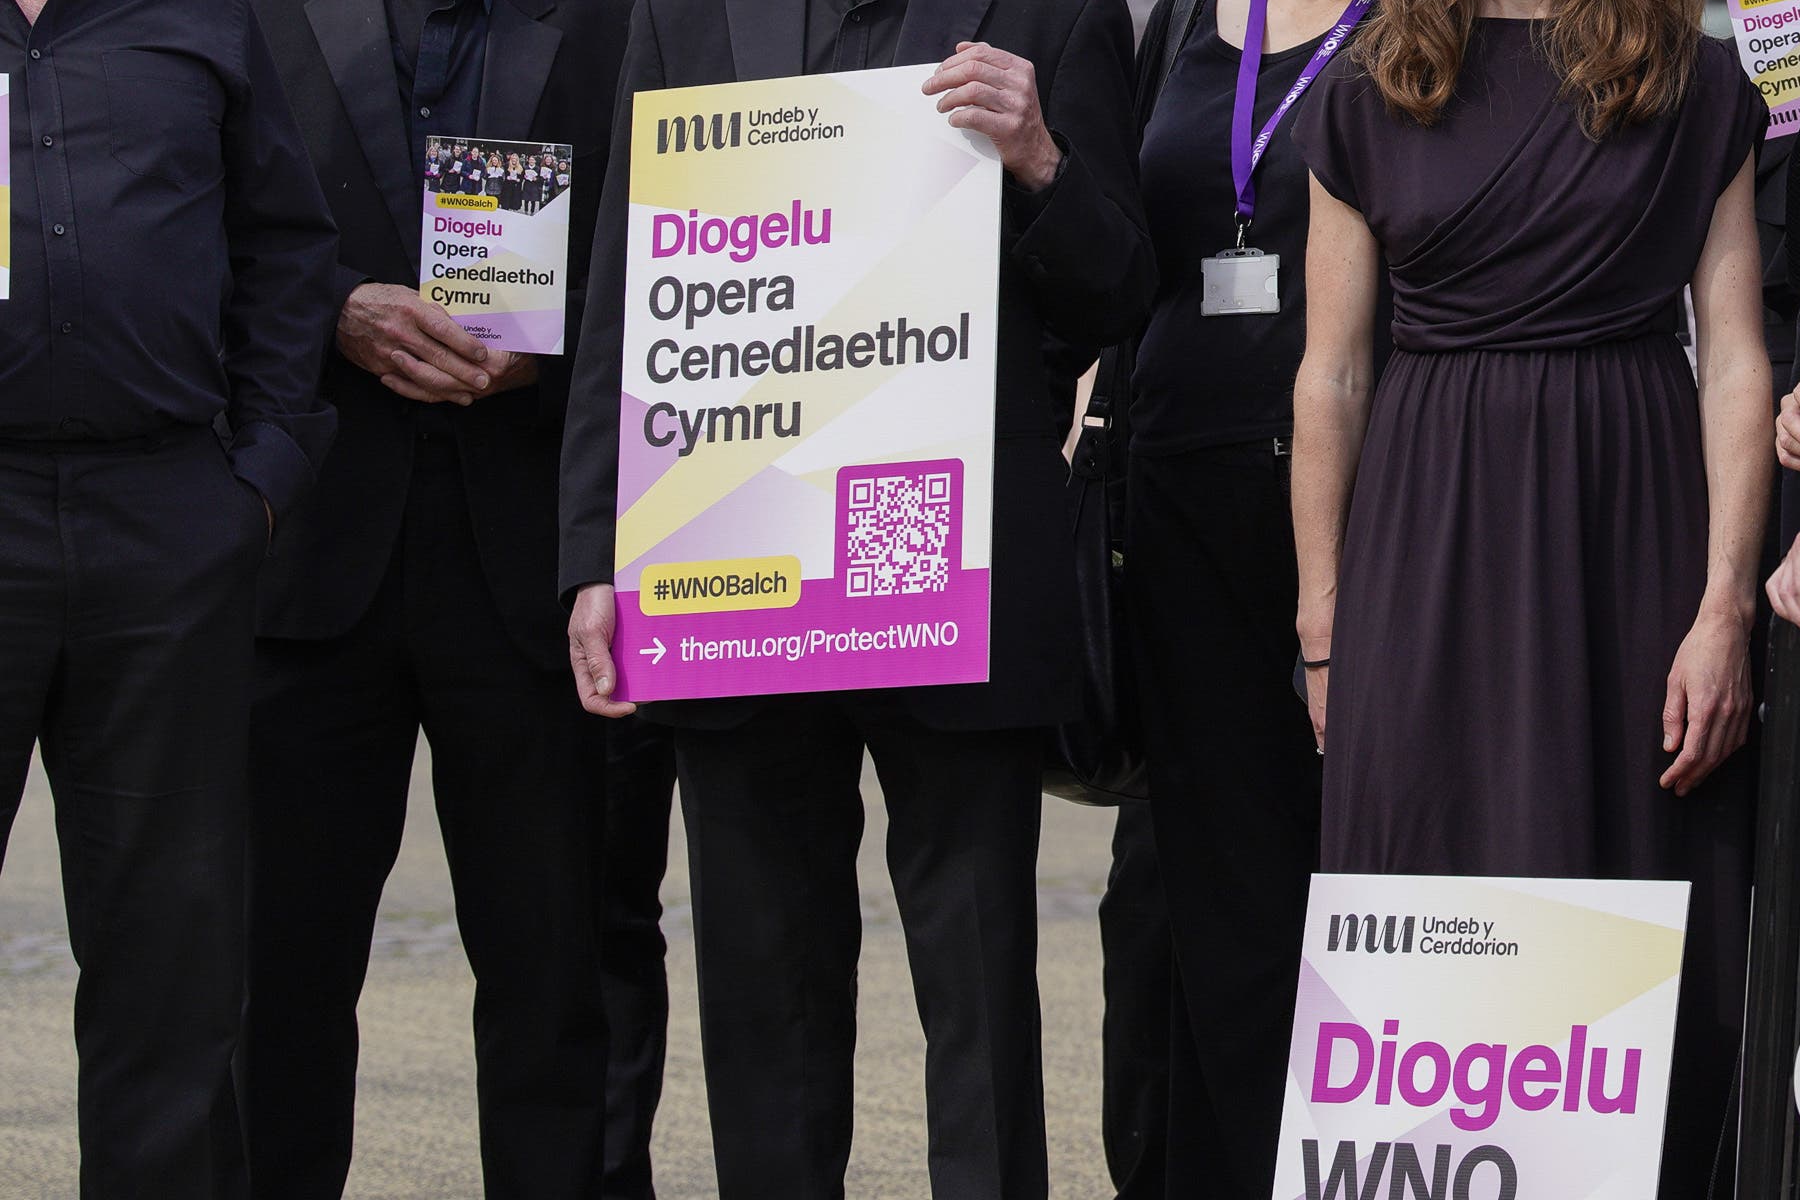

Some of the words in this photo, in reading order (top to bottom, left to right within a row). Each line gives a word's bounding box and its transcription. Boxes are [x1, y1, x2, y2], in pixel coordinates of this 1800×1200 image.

[748, 108, 805, 128] Undeb
[807, 107, 819, 127] y
[747, 122, 845, 146] Cerddorion
[440, 197, 493, 208] #WNOBalch
[434, 216, 503, 238] Diogelu
[651, 200, 832, 263] Diogelu
[433, 240, 488, 259] Opera
[432, 263, 554, 286] Cenedlaethol
[431, 286, 491, 306] Cymru
[648, 274, 795, 330] Opera
[646, 313, 971, 384] Cenedlaethol
[643, 402, 802, 457] Cymru
[653, 572, 787, 600] #WNOBalch
[680, 621, 959, 662] themu.org/ProtectWNO
[1422, 917, 1480, 935] Undeb
[1483, 921, 1494, 939] y
[1419, 937, 1518, 956] Cerddorion
[1310, 1019, 1642, 1132] Diogelu
[1301, 1139, 1518, 1200] WNO
